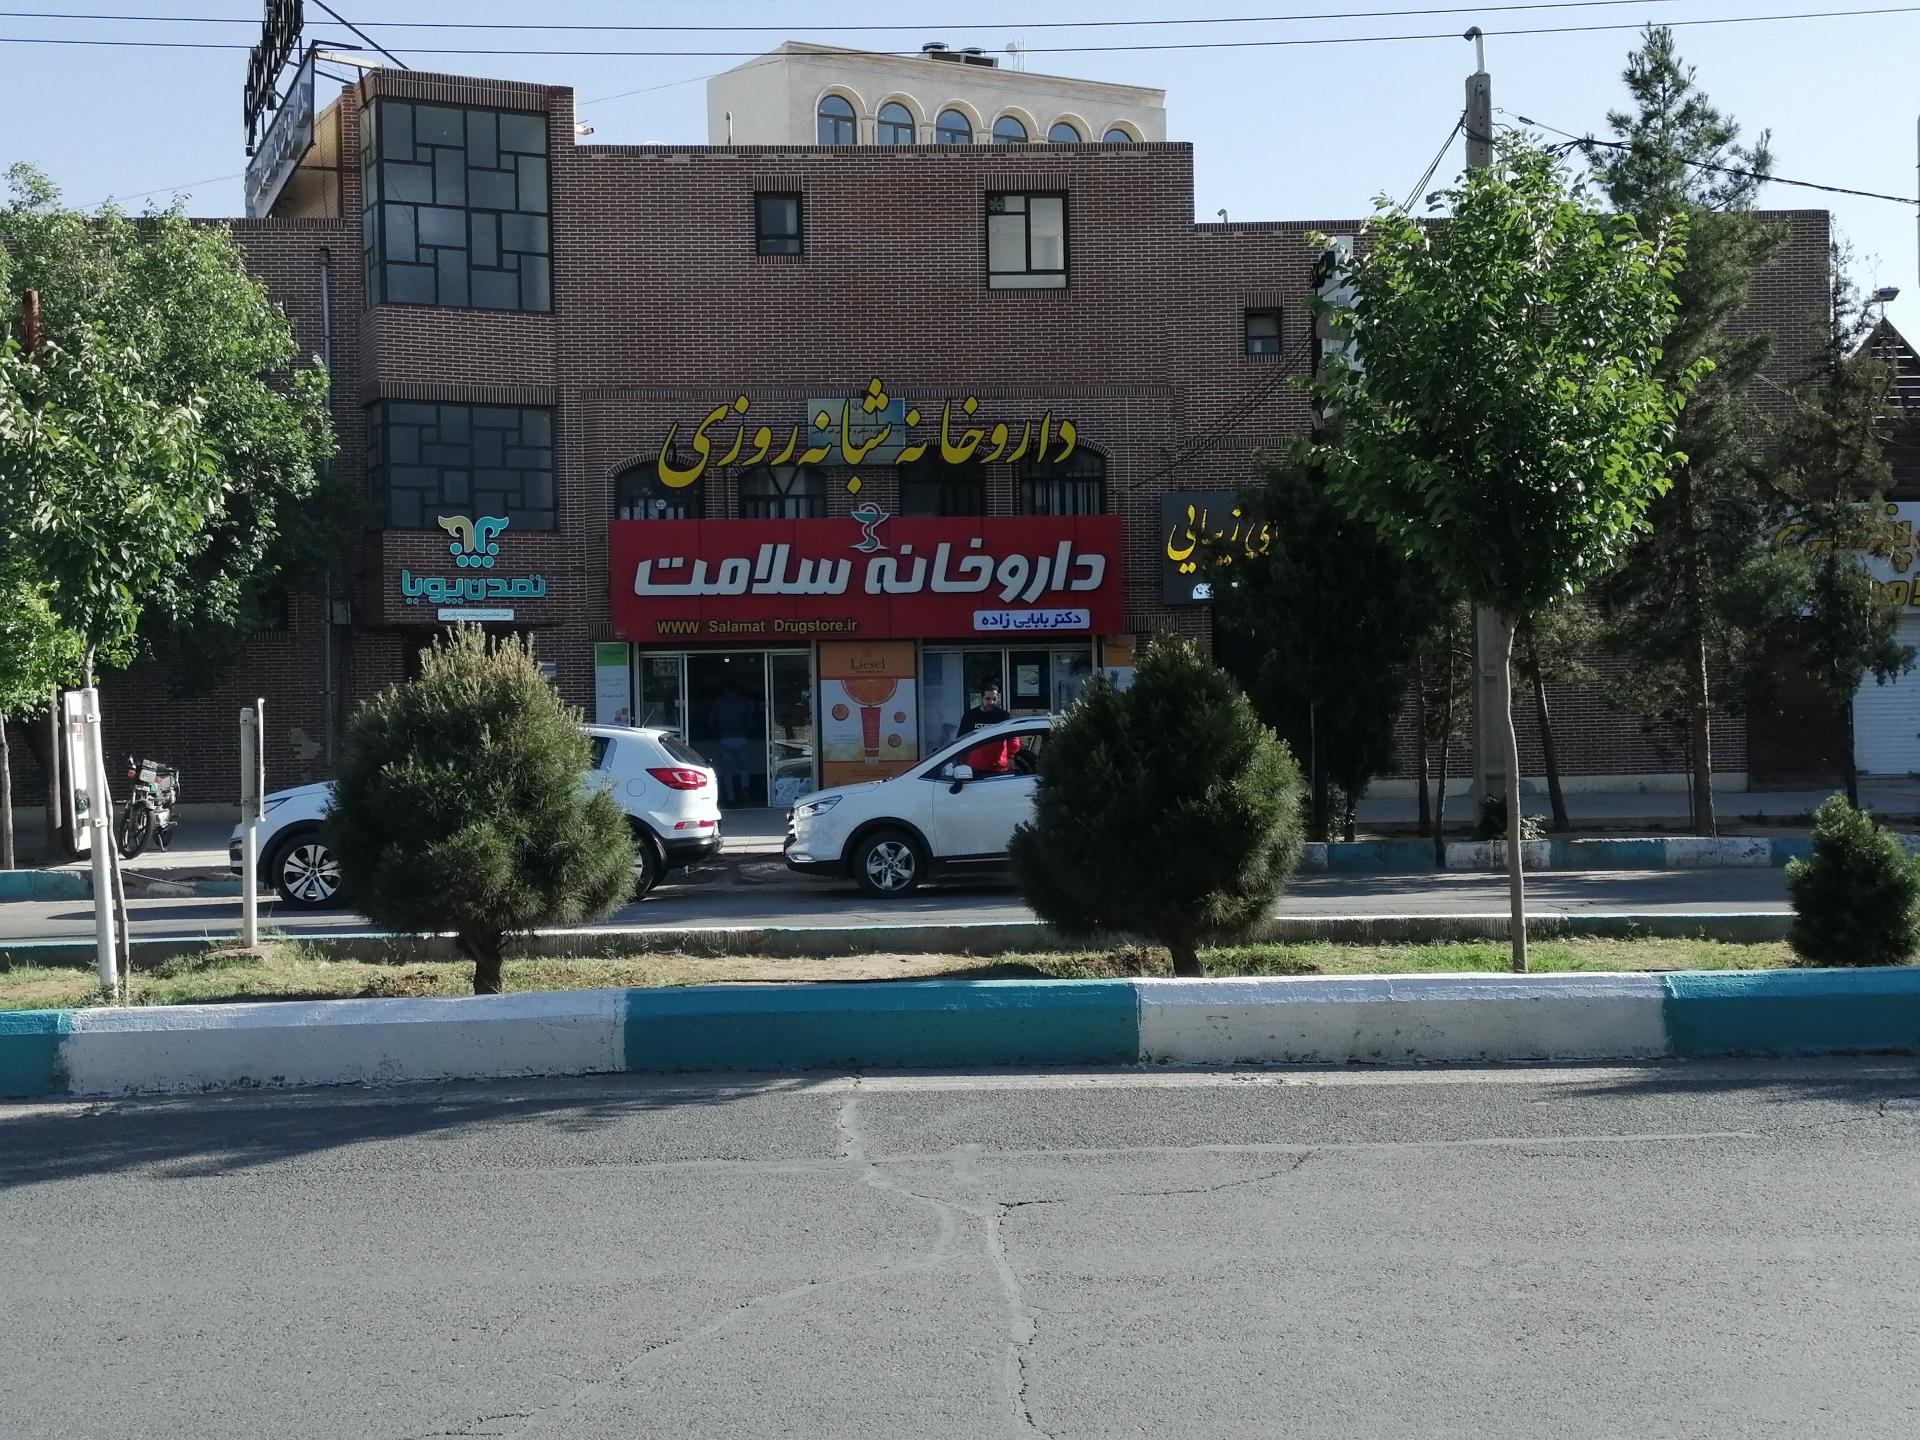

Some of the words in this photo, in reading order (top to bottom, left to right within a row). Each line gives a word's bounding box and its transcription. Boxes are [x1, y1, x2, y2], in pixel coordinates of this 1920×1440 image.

[658, 394, 799, 488] روزی
[799, 377, 893, 494] شبانه
[896, 397, 1078, 465] داروخانه
[633, 543, 853, 597] سلامت
[863, 538, 1107, 605] داروخانه
[708, 619, 766, 633] Salamat
[773, 618, 858, 635] Drugstore.ir
[981, 612, 1010, 628] زاده
[1013, 612, 1049, 629] بابایی
[1050, 611, 1082, 628] دکتر
